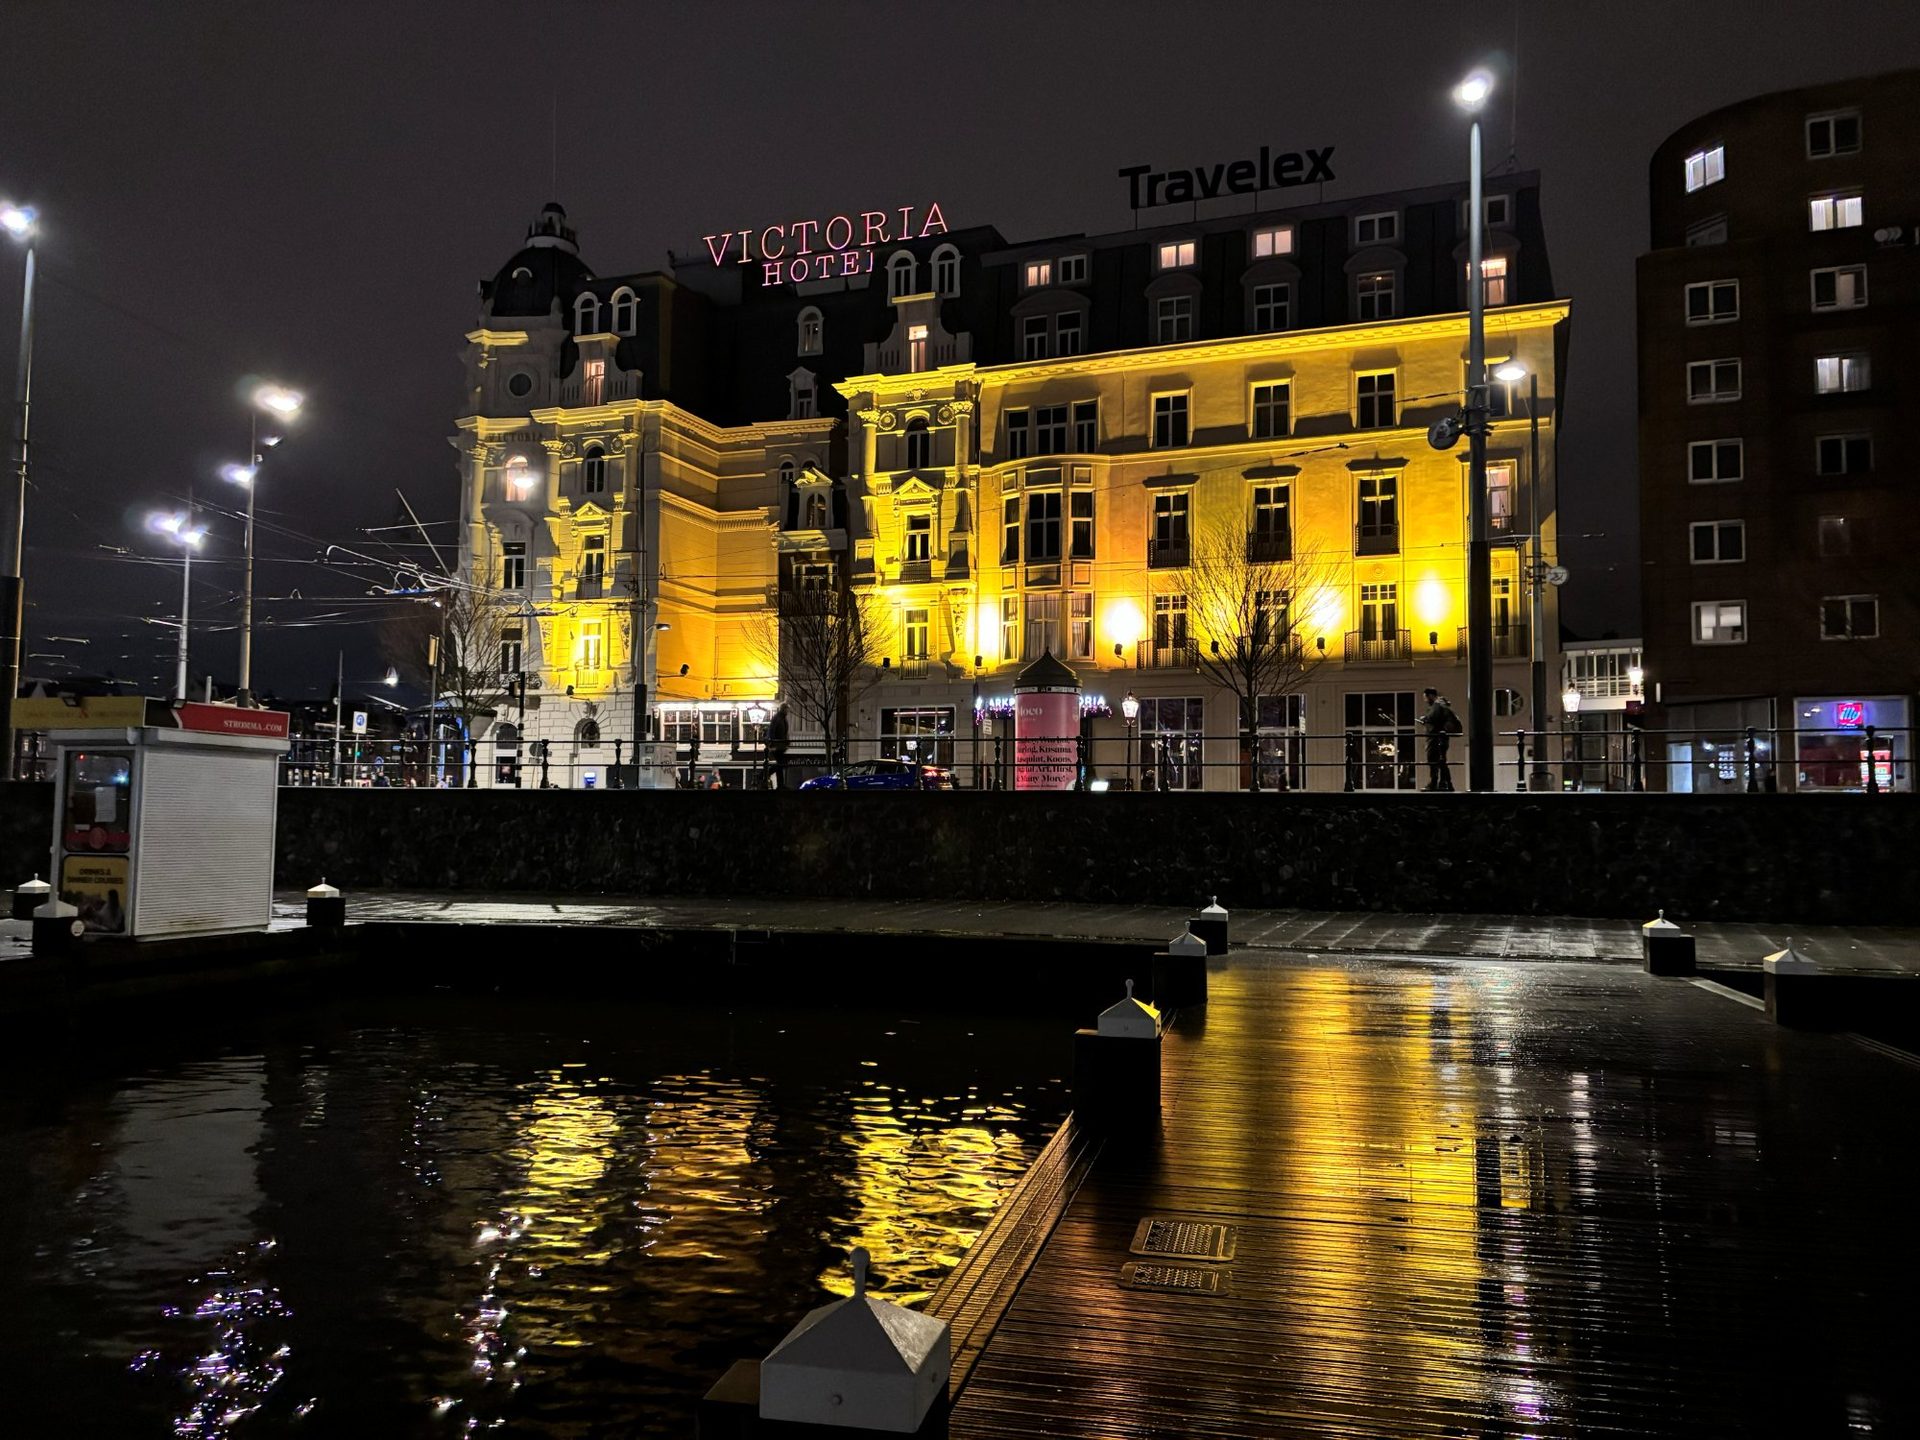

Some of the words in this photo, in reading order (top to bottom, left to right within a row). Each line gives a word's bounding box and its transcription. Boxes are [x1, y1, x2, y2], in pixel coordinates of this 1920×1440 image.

[1118, 146, 1336, 210] Travelex
[703, 202, 948, 267] VICTORIA
[1840, 707, 1860, 722] illy
